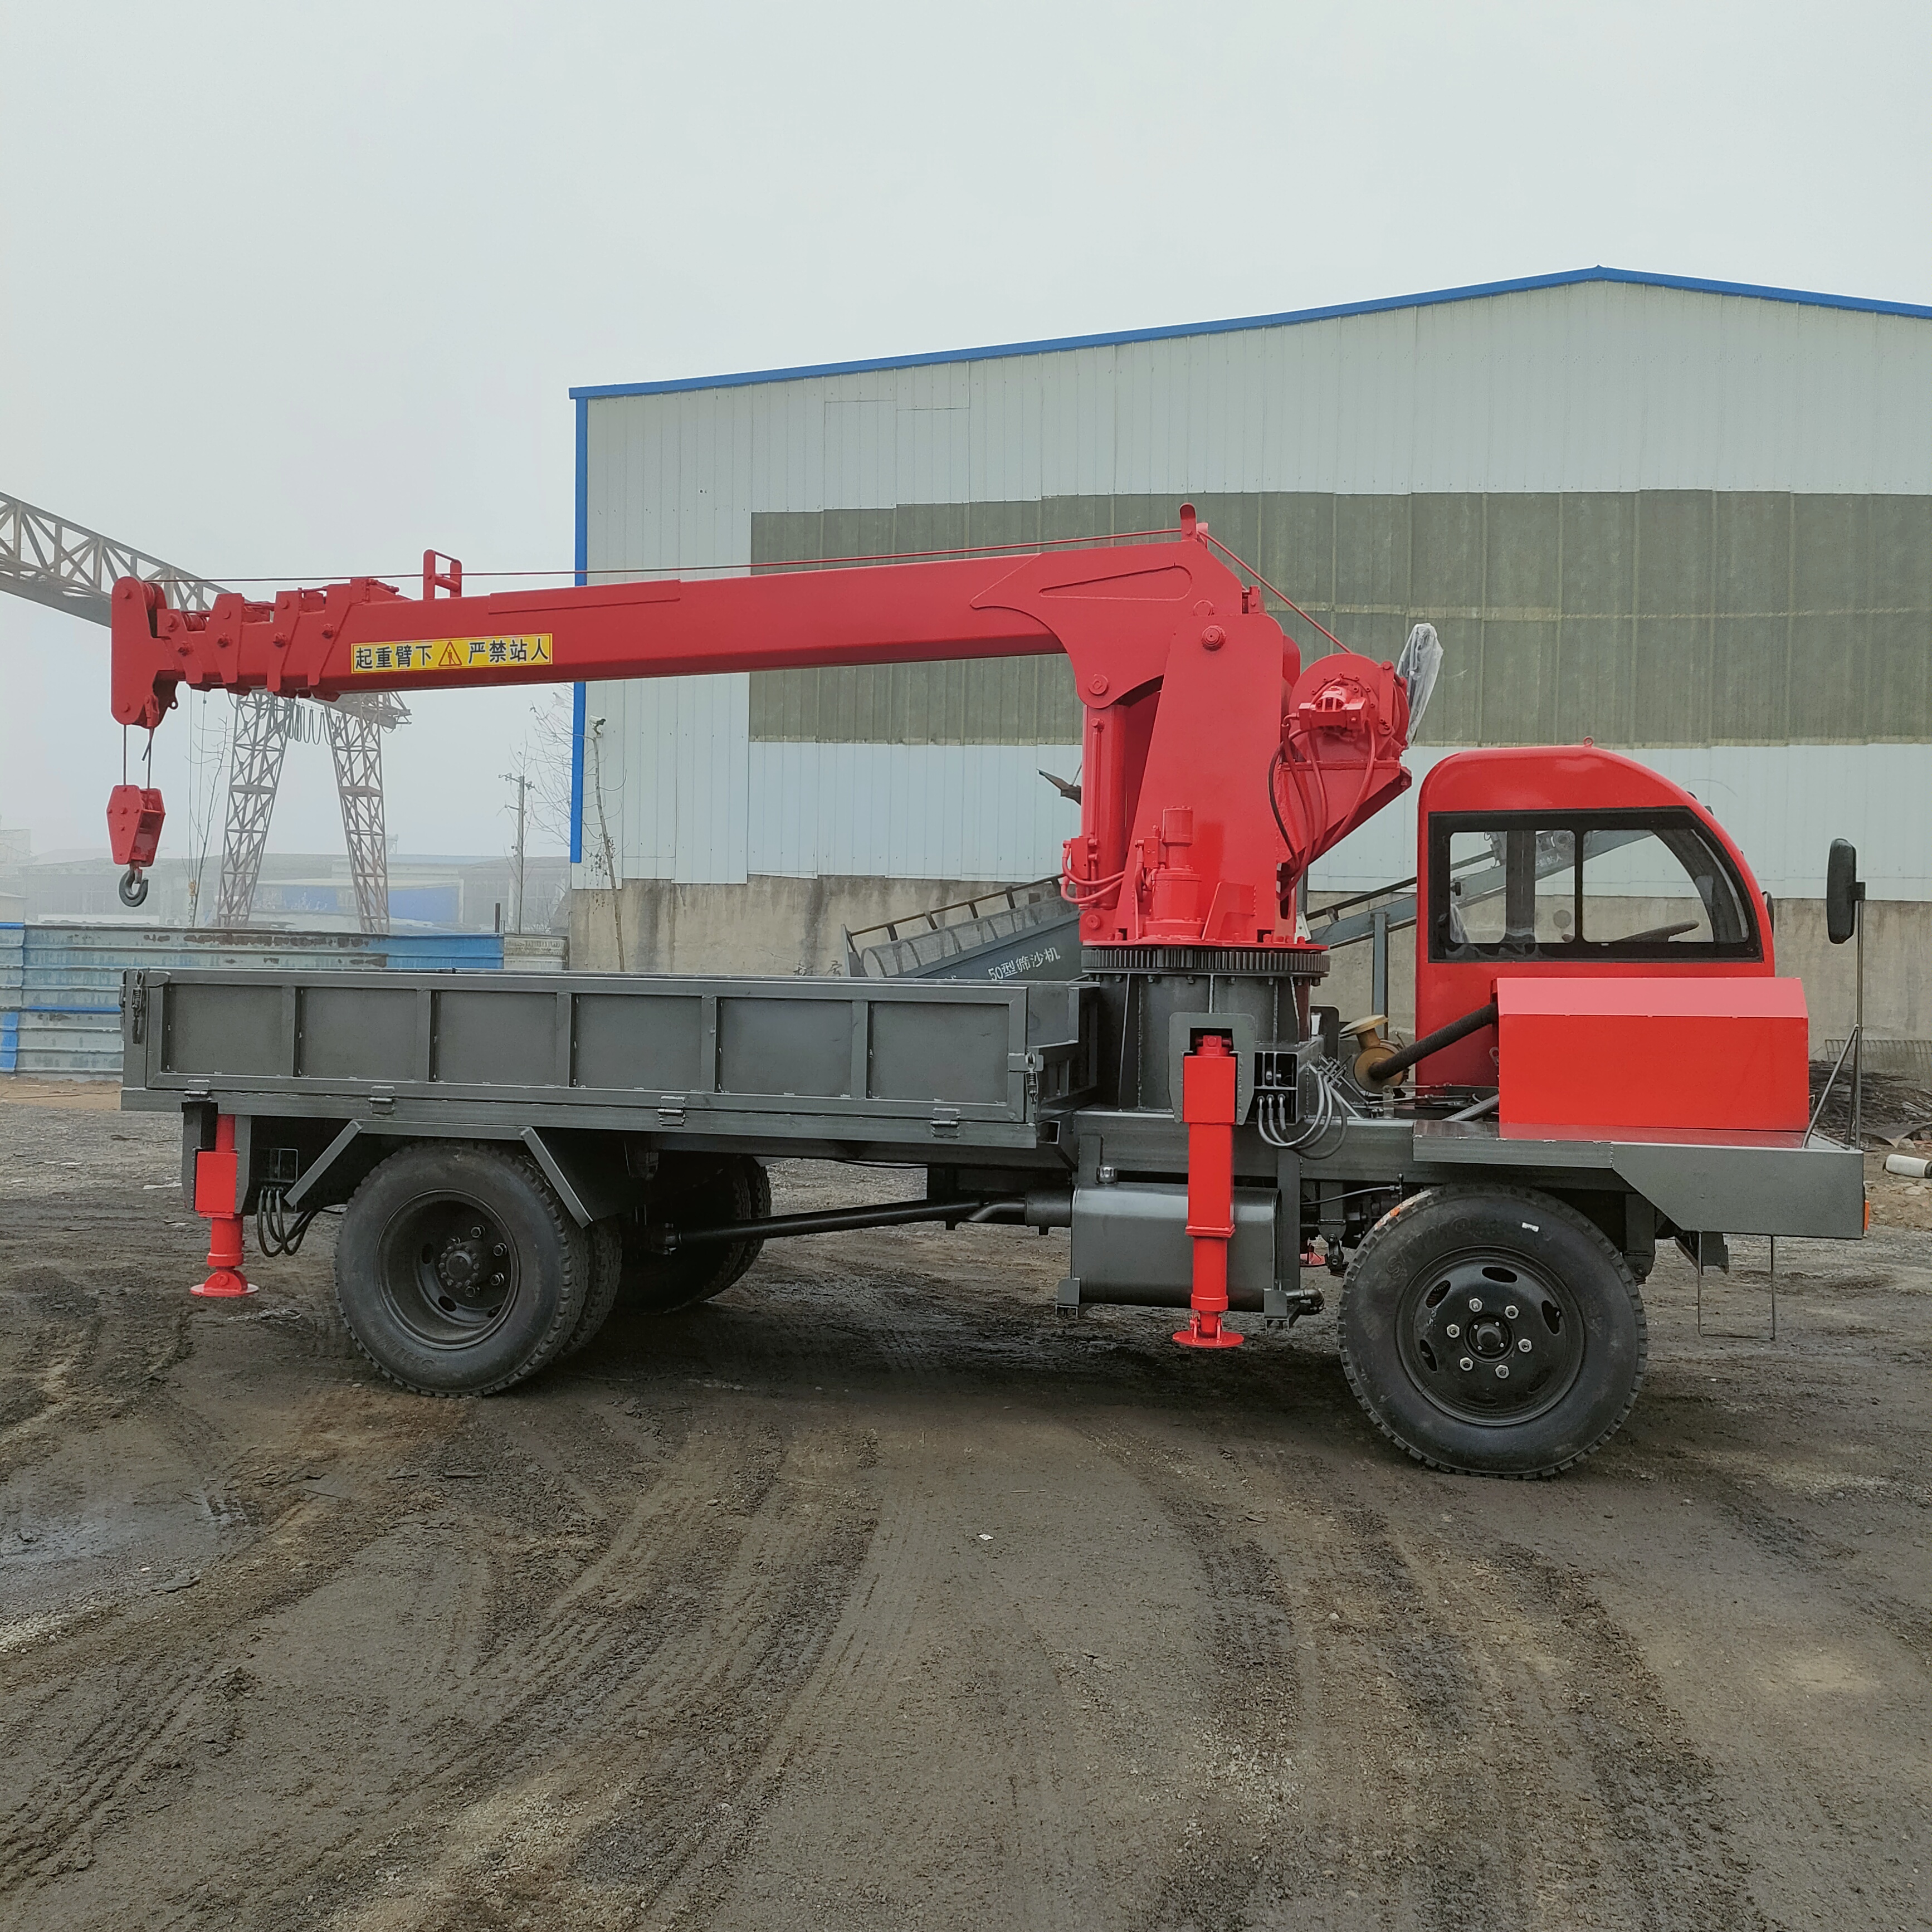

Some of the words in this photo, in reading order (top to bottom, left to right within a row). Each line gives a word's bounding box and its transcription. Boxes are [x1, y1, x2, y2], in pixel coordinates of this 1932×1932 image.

[355, 644, 433, 670] 起重臂下
[468, 638, 548, 665] 严禁站人
[988, 947, 1061, 980] 50型筛沙机
